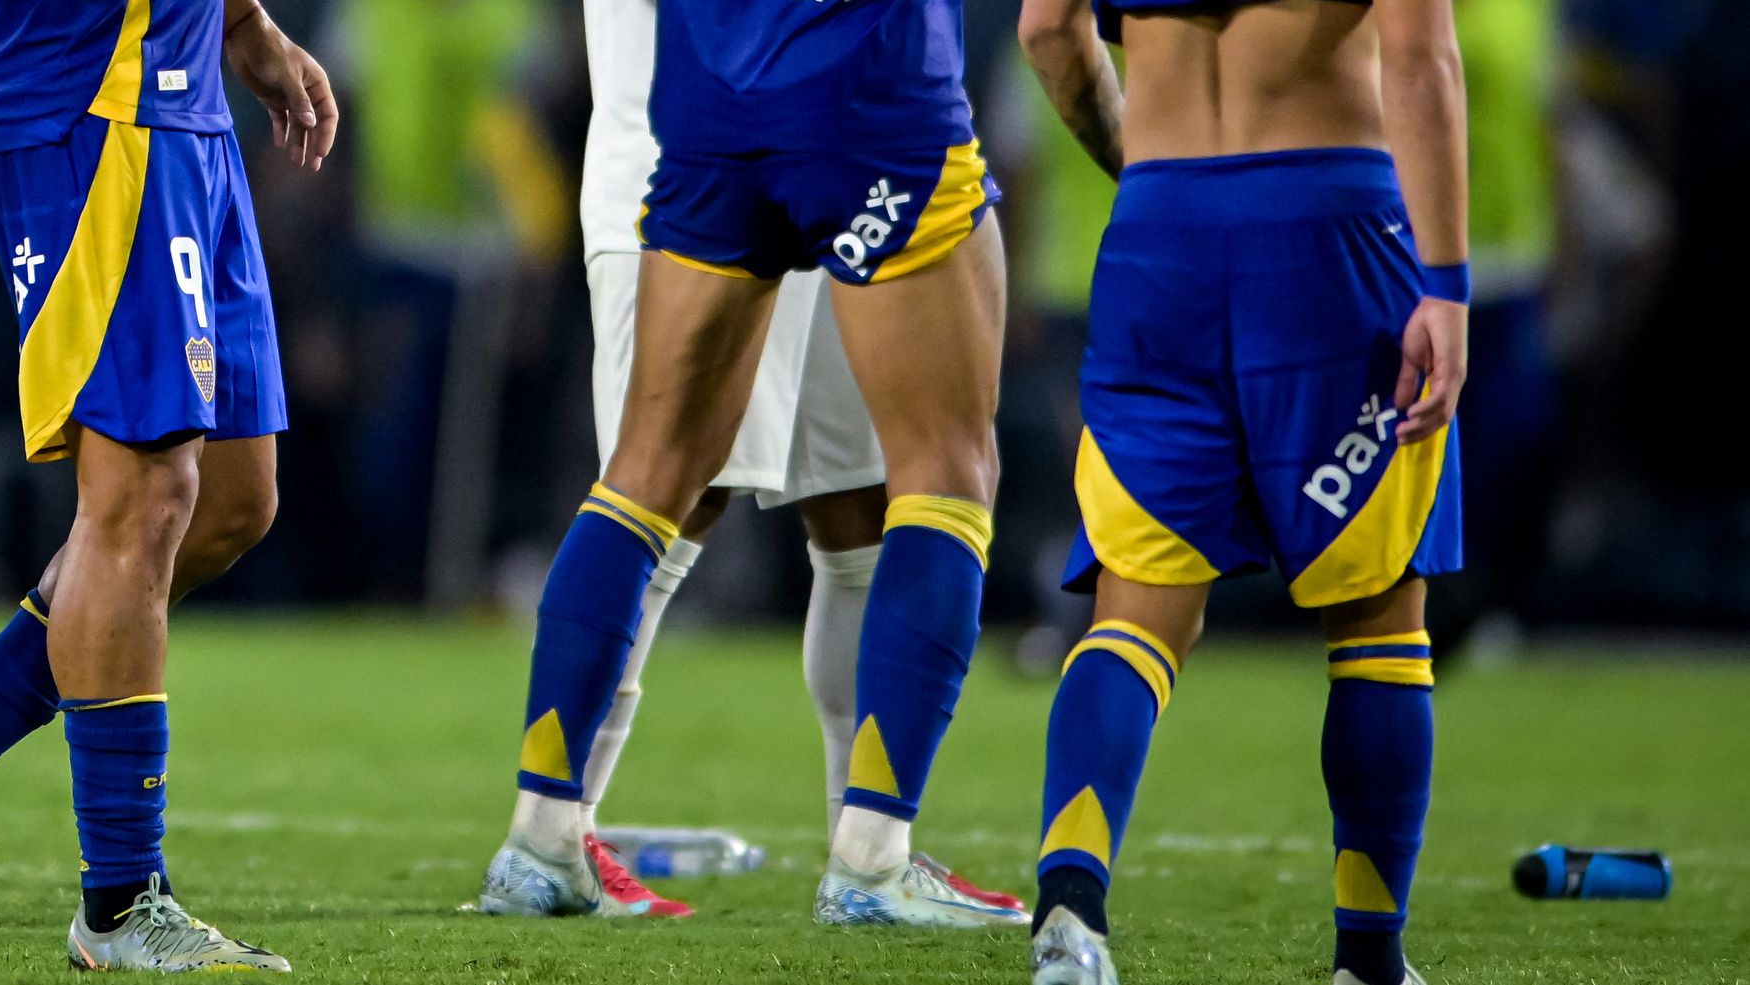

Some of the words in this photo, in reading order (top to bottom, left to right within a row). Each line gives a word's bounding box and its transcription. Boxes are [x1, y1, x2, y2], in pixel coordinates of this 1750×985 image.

[832, 178, 911, 278] pax
[169, 236, 209, 328] 9
[1302, 393, 1399, 520] pax
